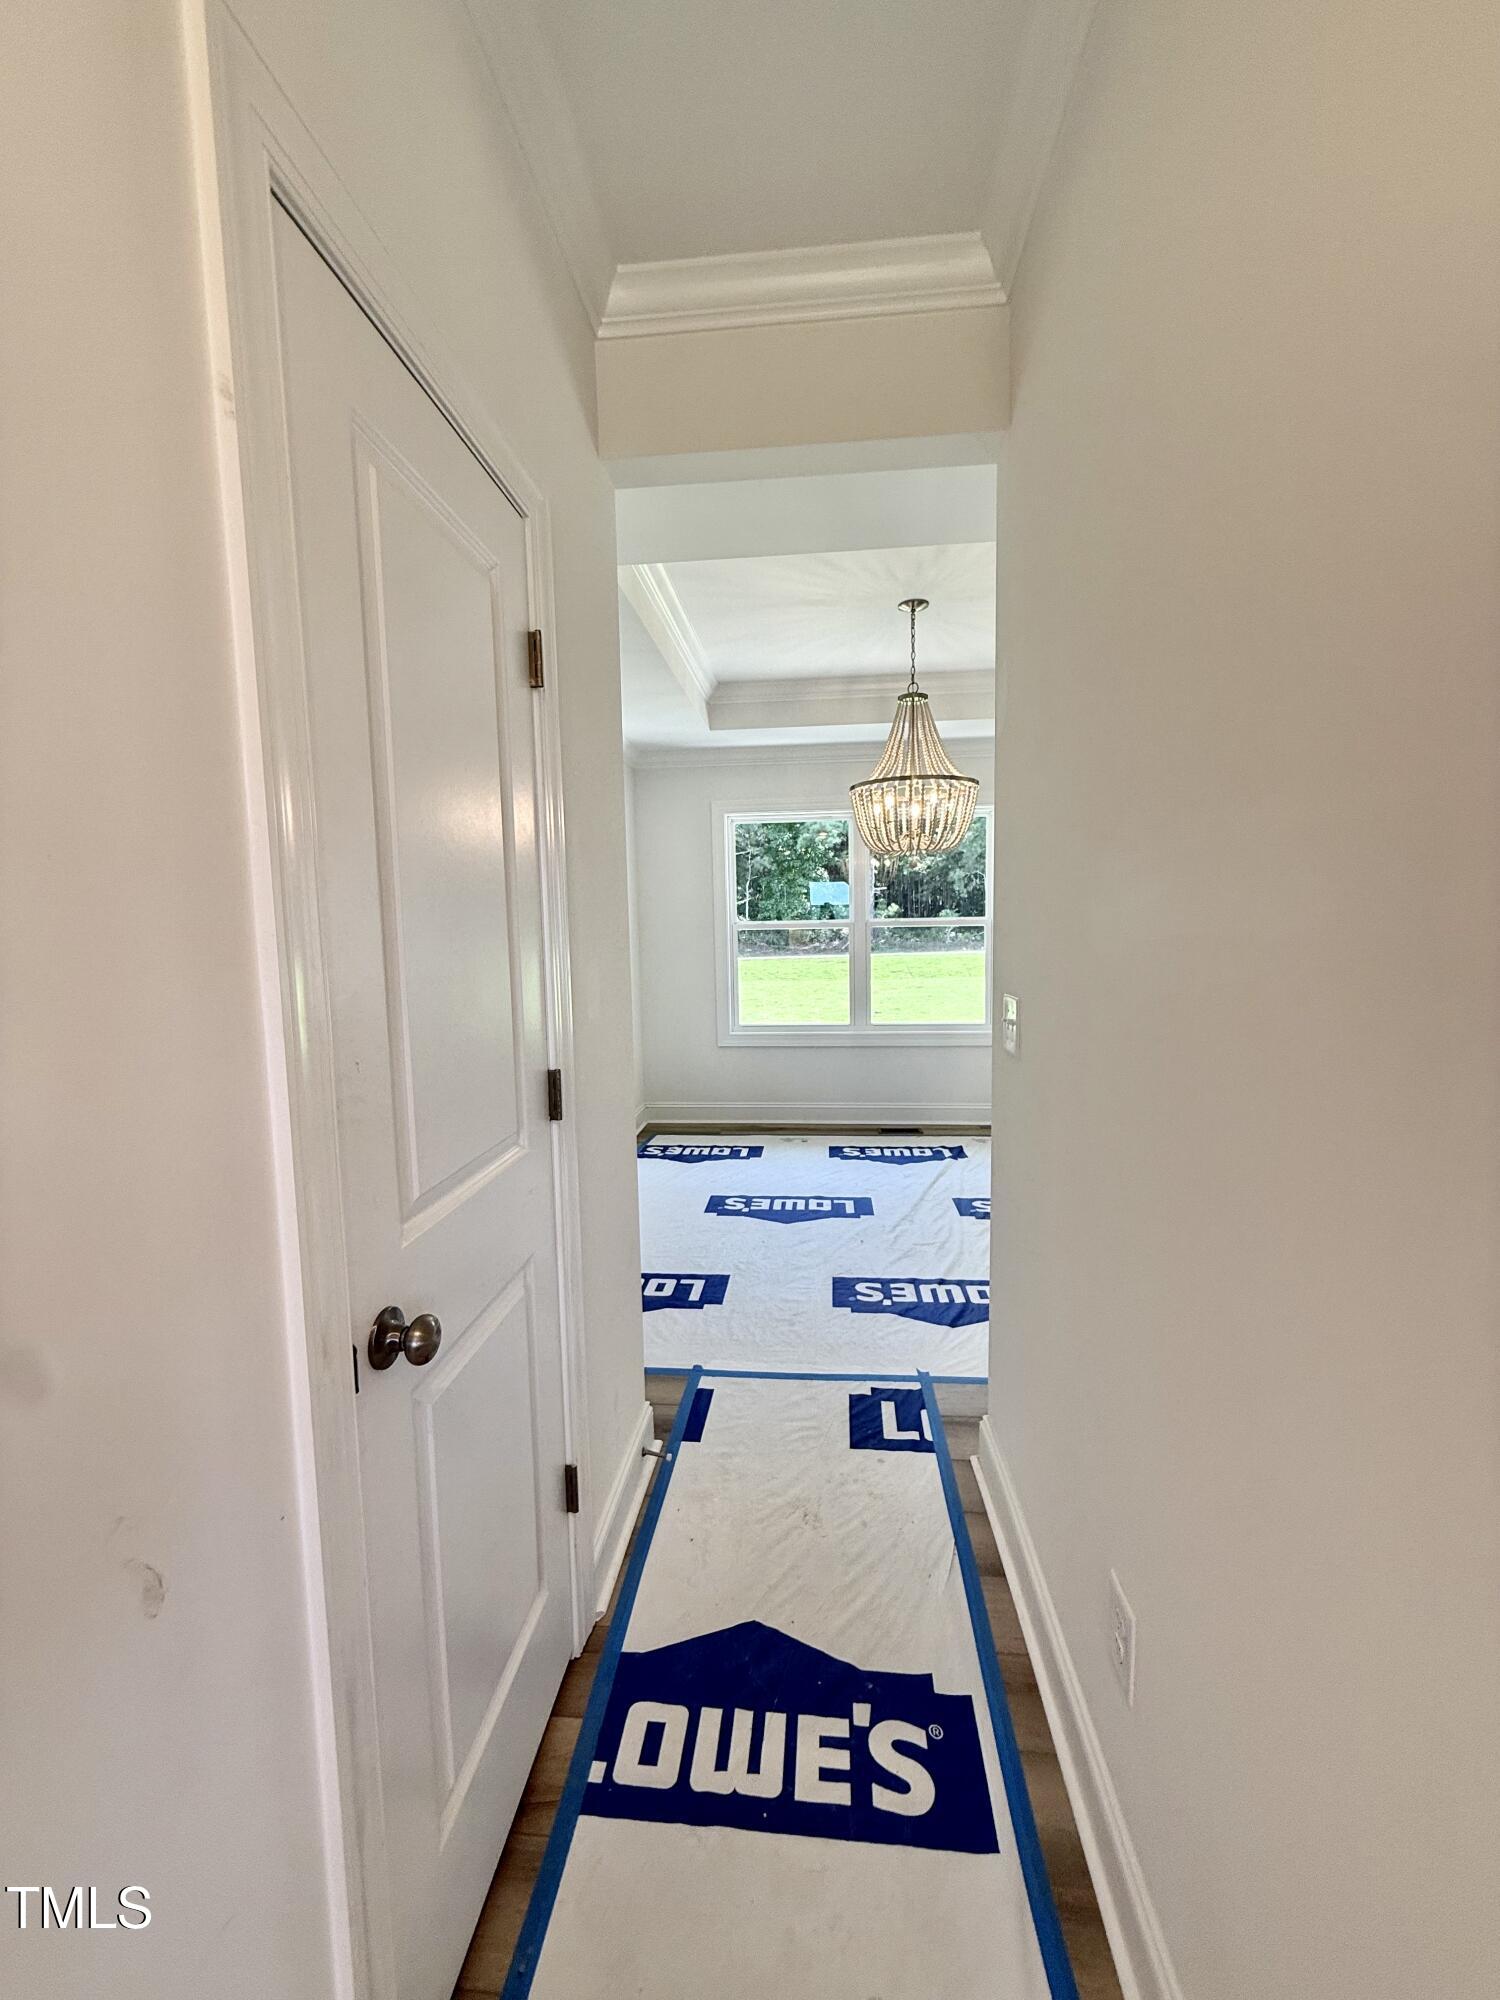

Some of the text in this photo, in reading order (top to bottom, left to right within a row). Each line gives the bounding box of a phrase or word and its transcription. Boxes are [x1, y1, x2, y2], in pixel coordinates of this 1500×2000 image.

[643, 1146, 749, 1157] LOWE'S
[842, 1147, 954, 1159] LOWE'S
[724, 1197, 856, 1214] LOWE'S
[641, 1279, 705, 1301] LO
[855, 1281, 990, 1305] OWE'S
